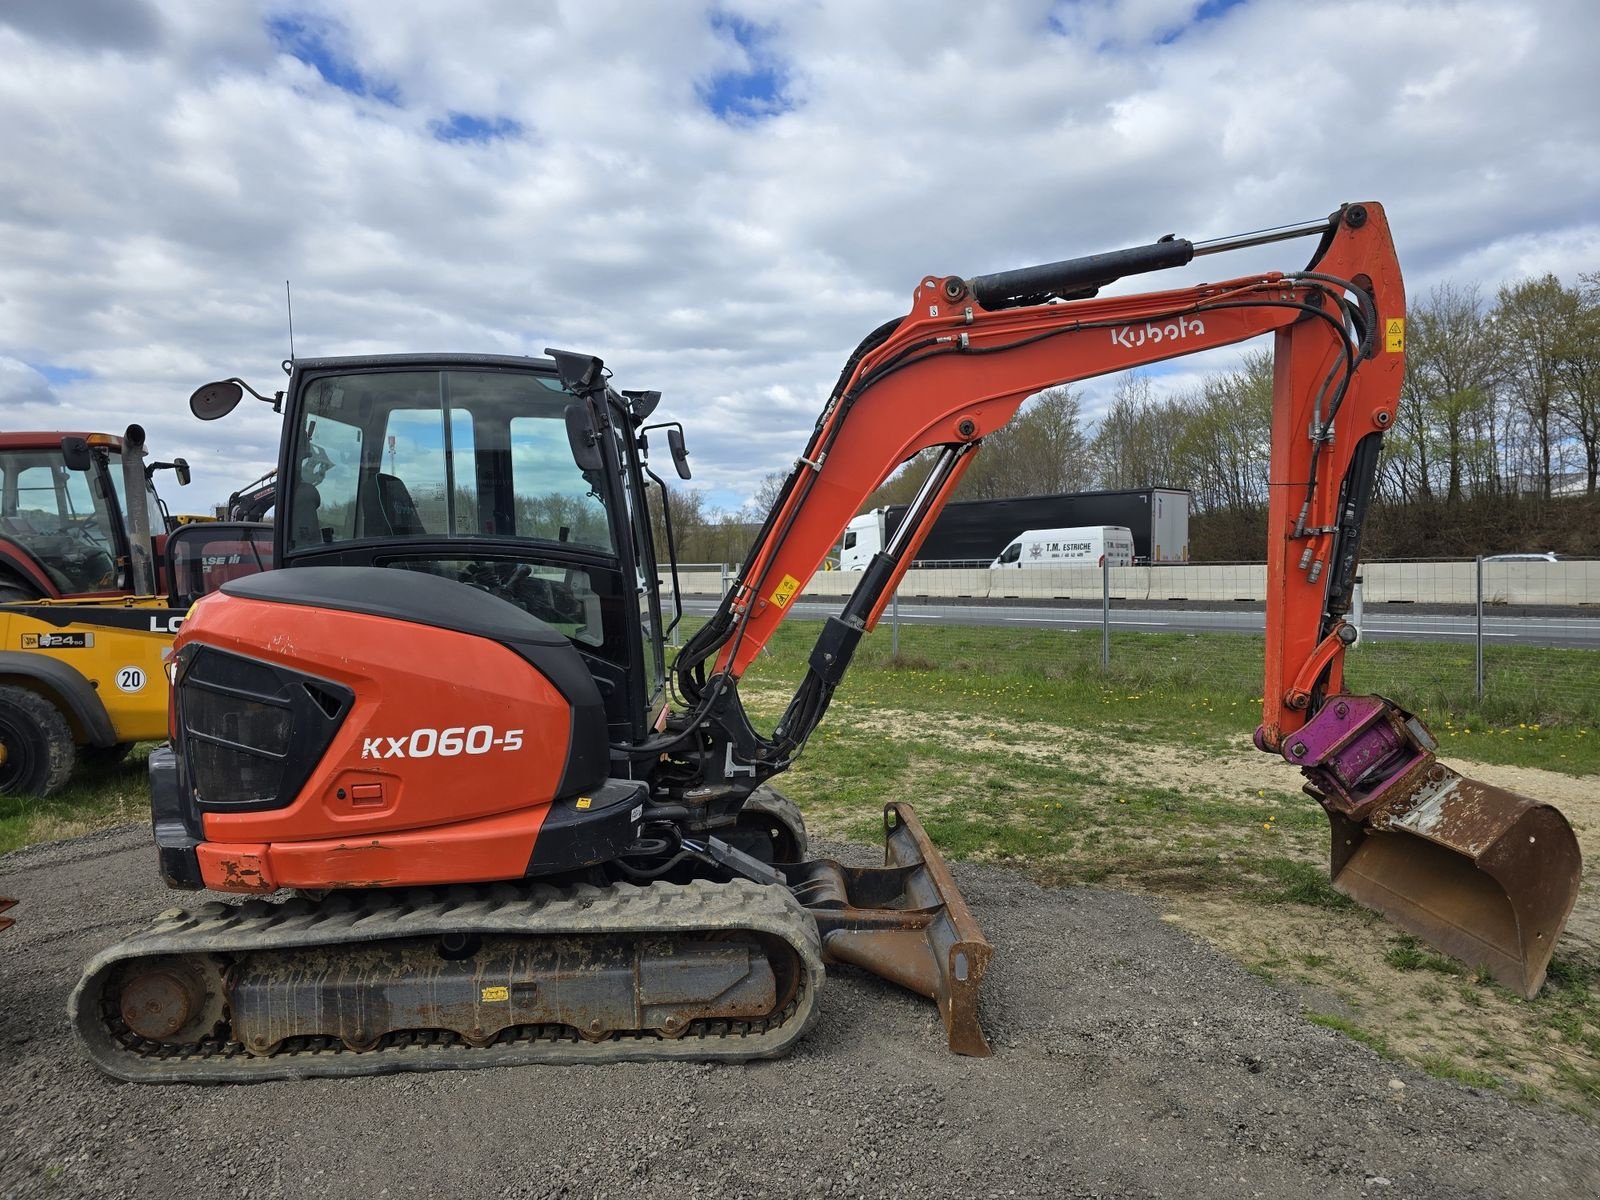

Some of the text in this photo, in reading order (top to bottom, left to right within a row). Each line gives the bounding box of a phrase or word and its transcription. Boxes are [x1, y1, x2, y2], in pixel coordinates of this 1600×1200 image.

[1111, 316, 1205, 348] Kubota
[1046, 542, 1092, 552] T.M. ESTRICHE
[202, 556, 226, 565] ASE
[122, 671, 141, 688] 20
[361, 725, 524, 759] KX060-5
